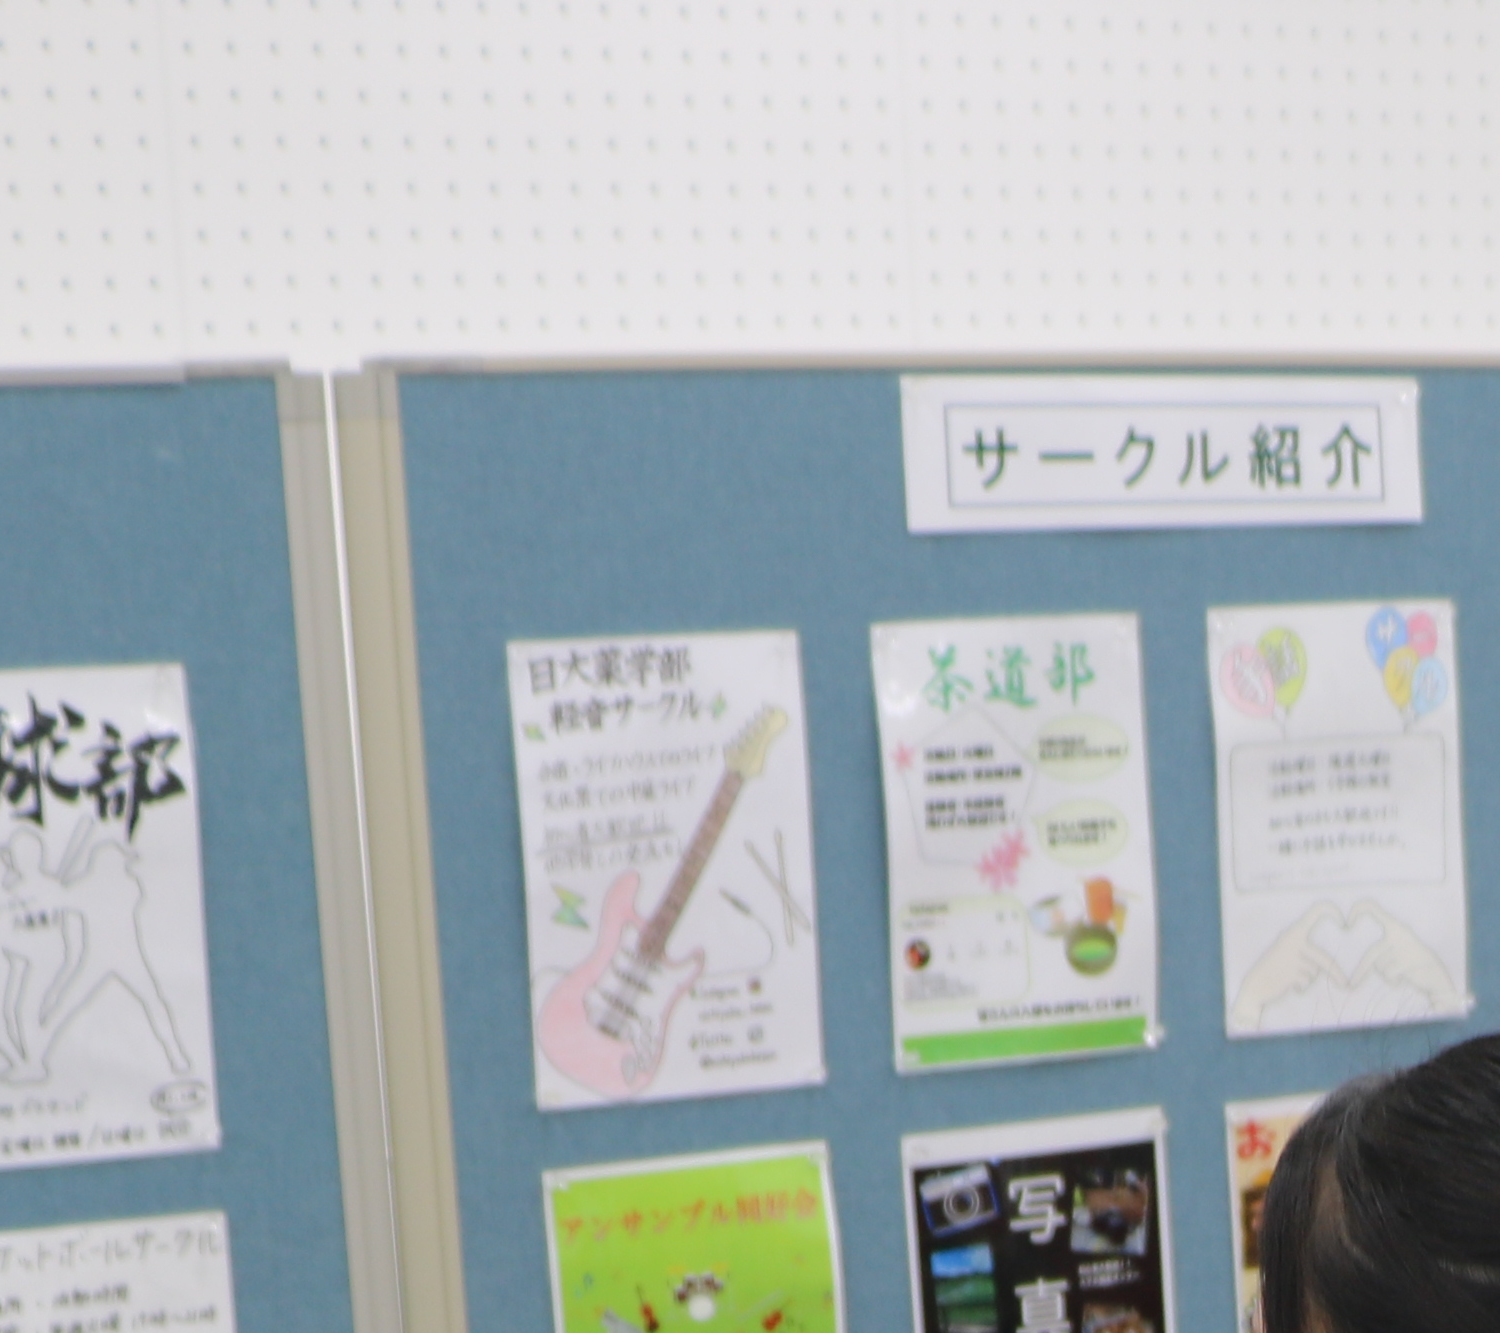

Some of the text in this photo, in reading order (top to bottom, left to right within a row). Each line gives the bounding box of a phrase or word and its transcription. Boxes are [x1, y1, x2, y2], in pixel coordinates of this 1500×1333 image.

[963, 423, 1372, 490] サークル紹介
[528, 645, 692, 694] 日大薬学部
[921, 641, 1095, 712] 茶道部
[550, 691, 700, 735] 軽音サークル
